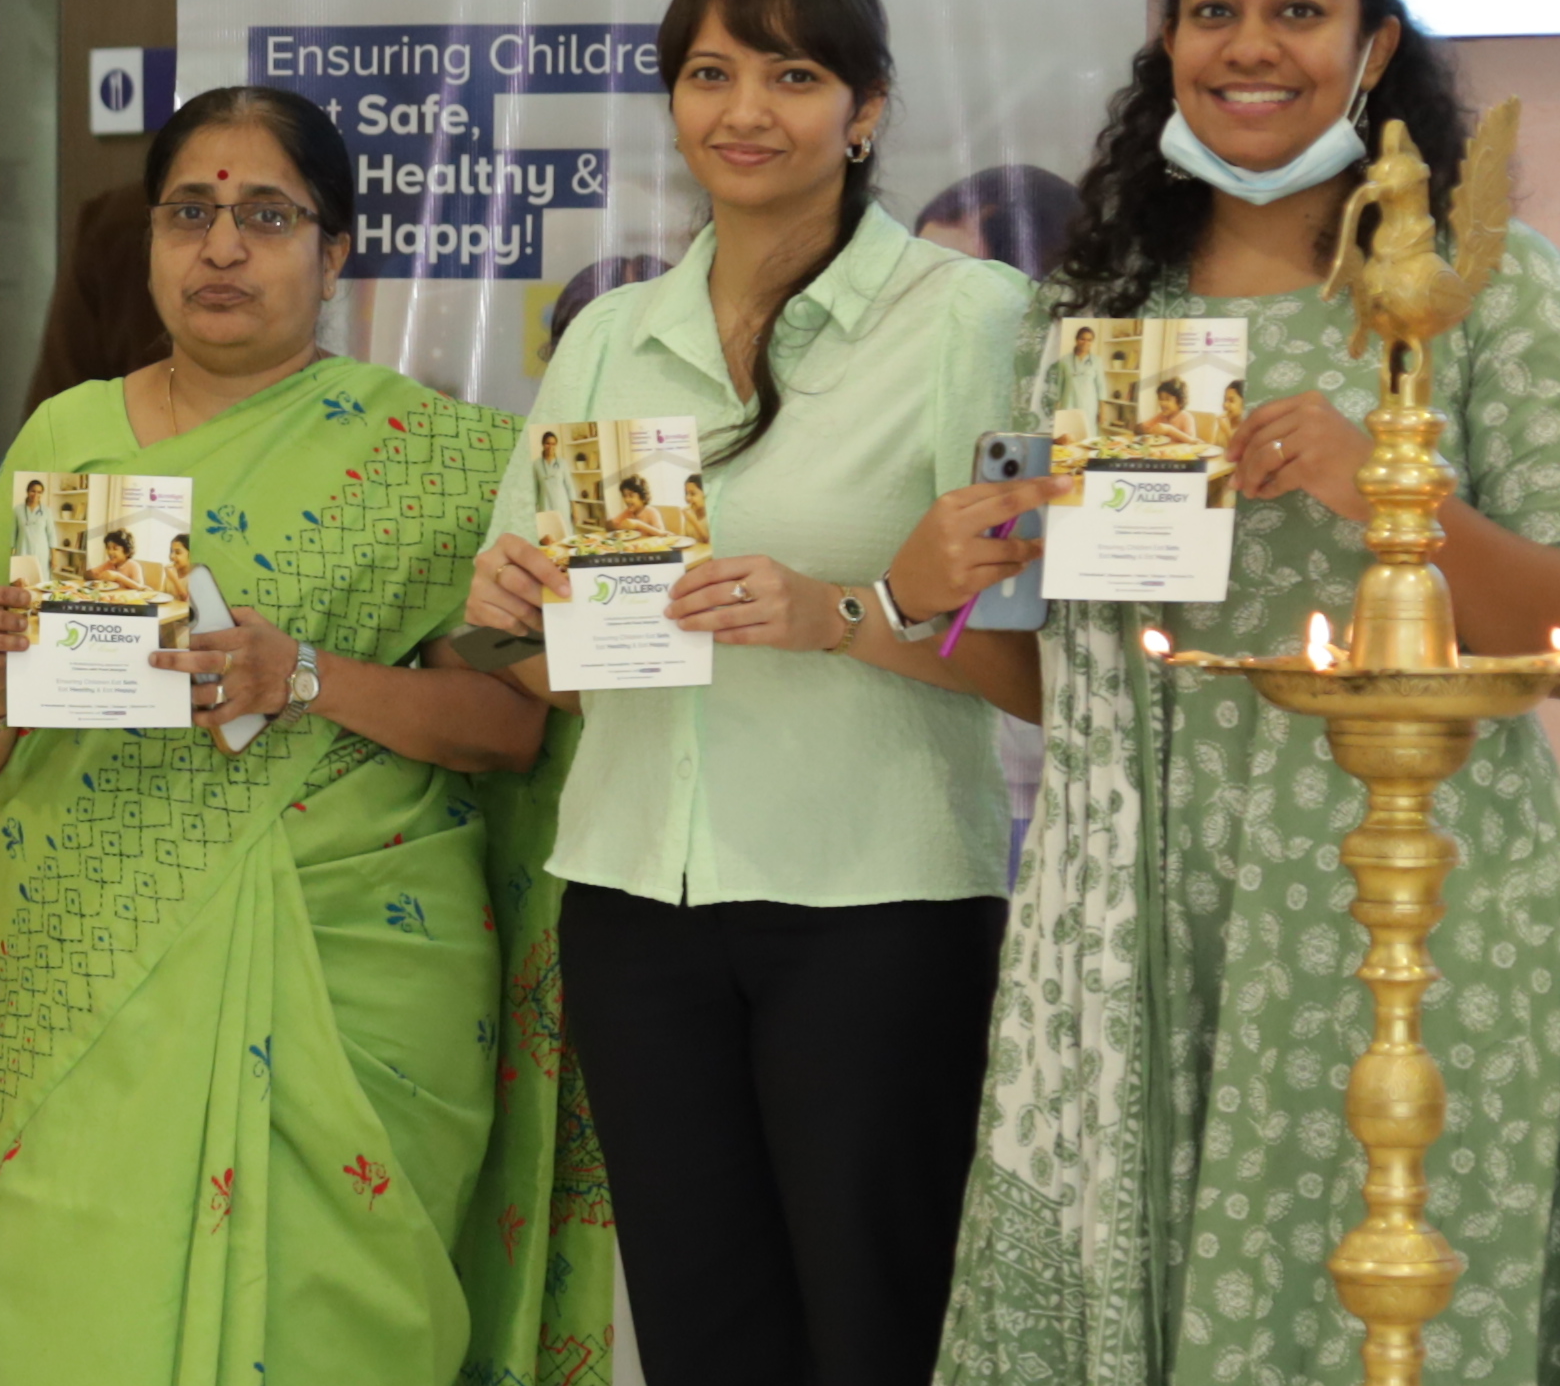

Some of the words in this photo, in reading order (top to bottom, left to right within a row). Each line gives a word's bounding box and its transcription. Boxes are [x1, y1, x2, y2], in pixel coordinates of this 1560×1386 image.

[267, 35, 471, 85] Ensuring
[489, 33, 661, 76] Childre
[357, 94, 481, 140] Safe,
[357, 153, 555, 205] Healthy
[571, 153, 605, 195] &
[357, 213, 534, 265] Happy!
[1137, 483, 1170, 493] FOOD
[1136, 492, 1188, 503] ALLERGY
[619, 574, 650, 585] FOOD
[620, 582, 670, 595] ALLERGY
[90, 624, 122, 634] FOOD
[89, 633, 141, 644] ALLERGY
